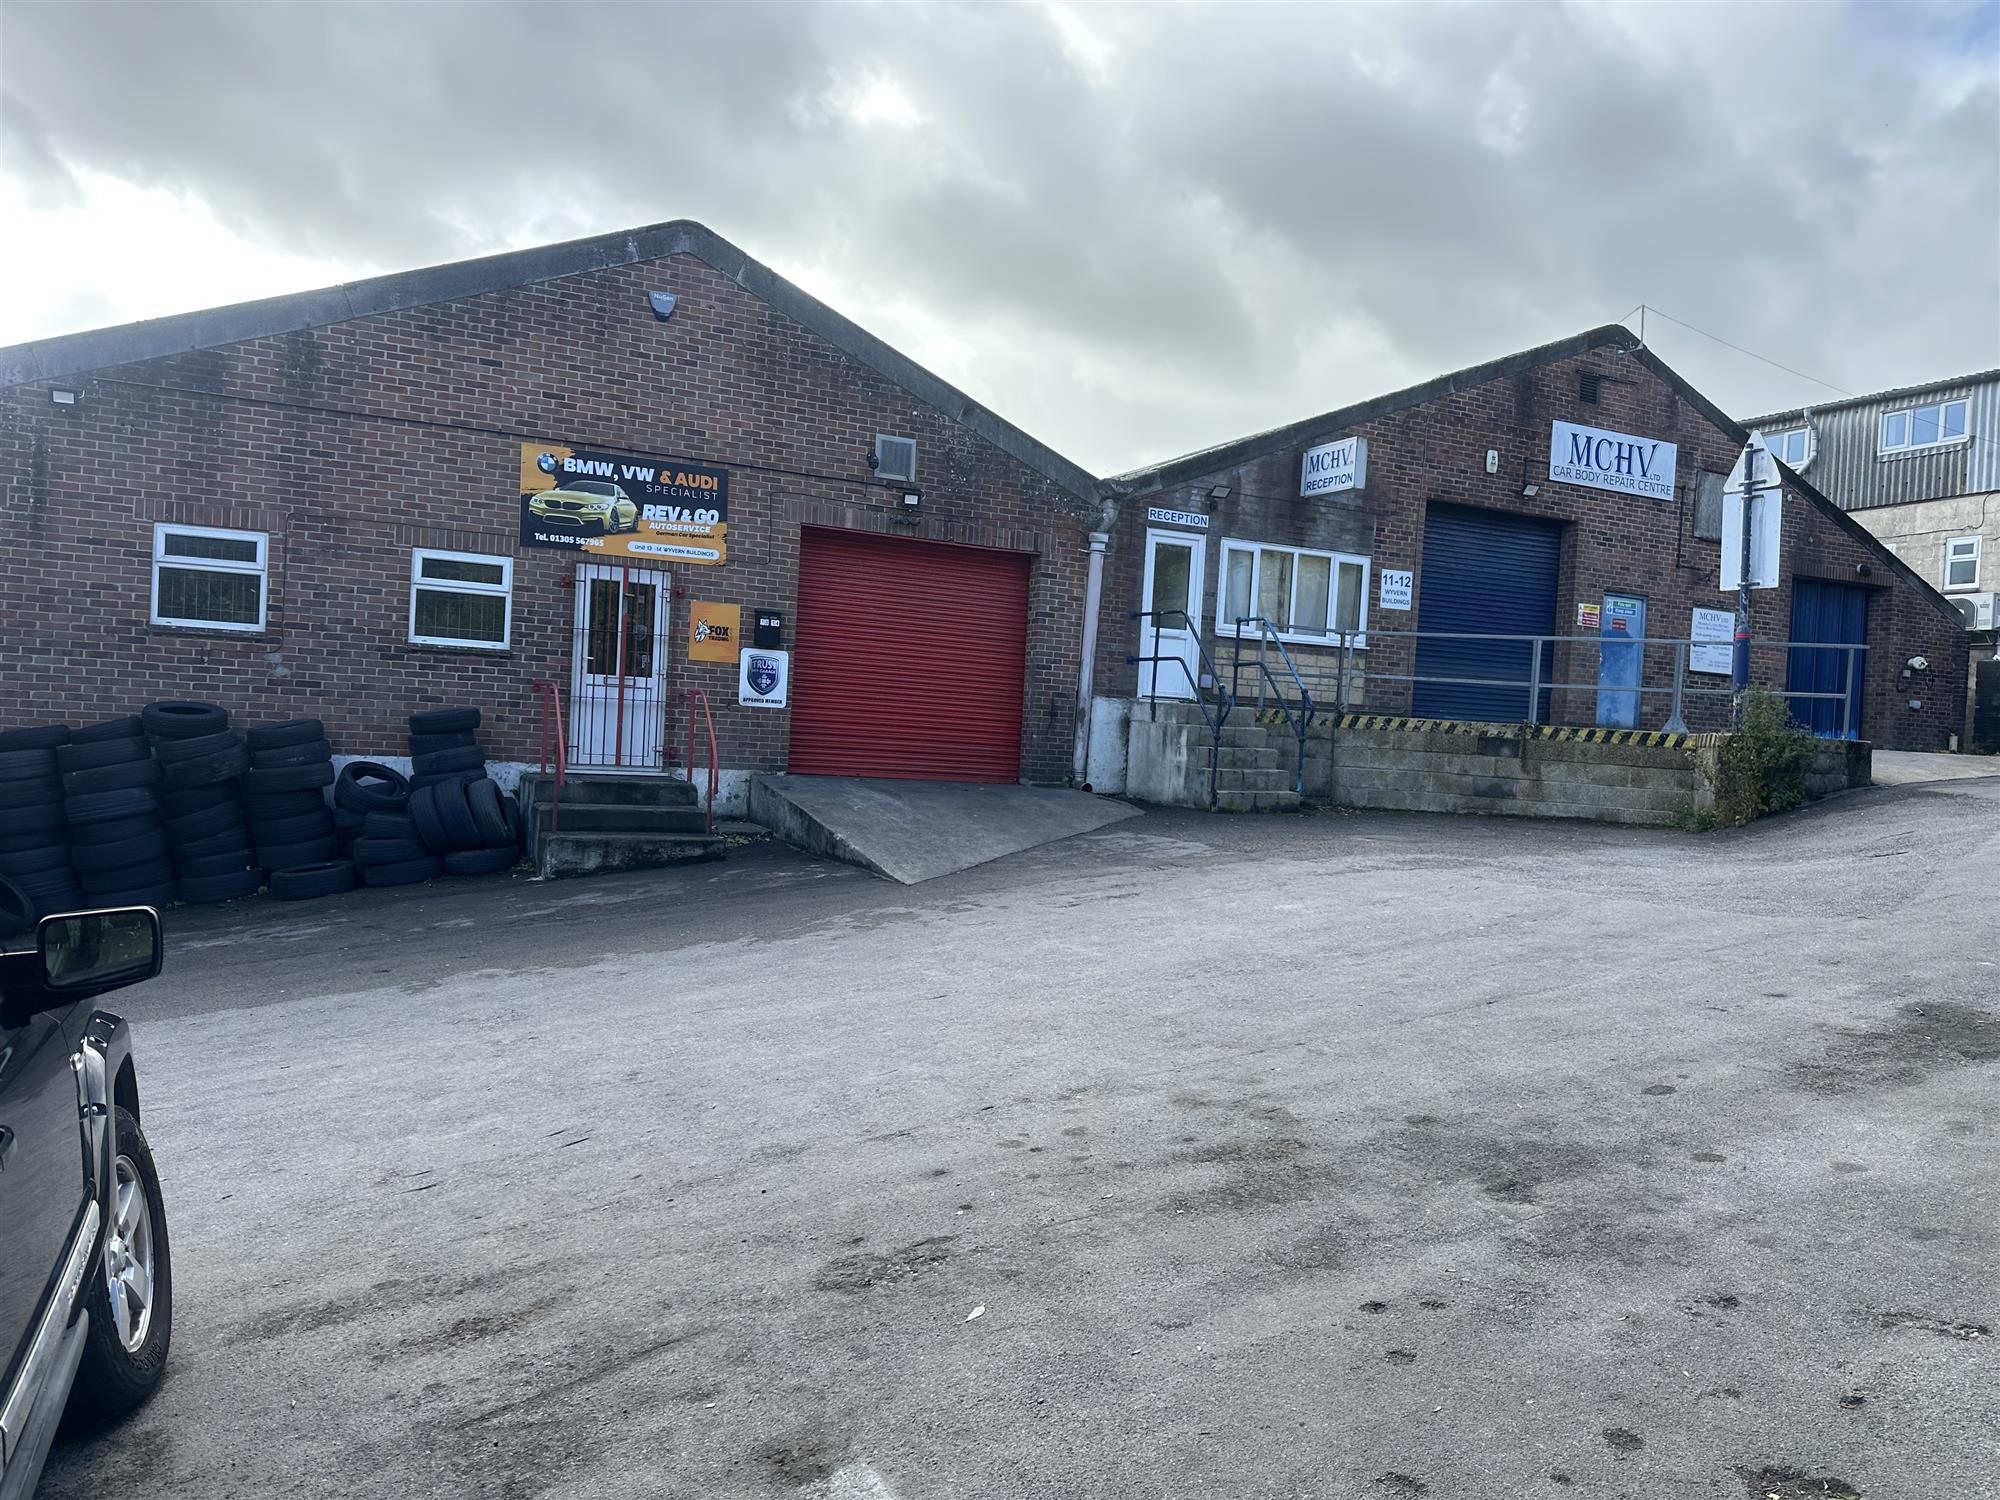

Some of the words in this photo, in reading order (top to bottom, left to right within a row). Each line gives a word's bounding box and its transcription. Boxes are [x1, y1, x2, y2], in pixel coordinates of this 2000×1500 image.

[1308, 442, 1354, 474] MCHV
[1567, 432, 1660, 479] MCHV
[1650, 473, 1661, 482] LTD
[563, 457, 618, 482] BMW,
[621, 465, 655, 482] VW
[659, 470, 671, 484] &
[674, 471, 718, 490] AUDI
[1306, 472, 1353, 491] RECEPTION
[1552, 465, 1573, 479] CAR
[1575, 470, 1600, 483] BODY
[1603, 474, 1635, 489] REPAIR
[1637, 481, 1672, 496] CENTRE
[646, 484, 718, 501] SPECIALIST
[1149, 509, 1208, 526] RECEPTION
[649, 522, 711, 533] AUTOSERVICE
[550, 534, 574, 544] 01305
[663, 546, 685, 555] WYVERN
[686, 549, 714, 557] BUILDINGS
[1382, 573, 1411, 588] 11-12
[1385, 589, 1408, 597] WYVERN
[1382, 597, 1410, 606] BUILDINGS
[1699, 611, 1722, 622] MCHV
[709, 625, 729, 637] FOX
[752, 659, 776, 670] TRUST
